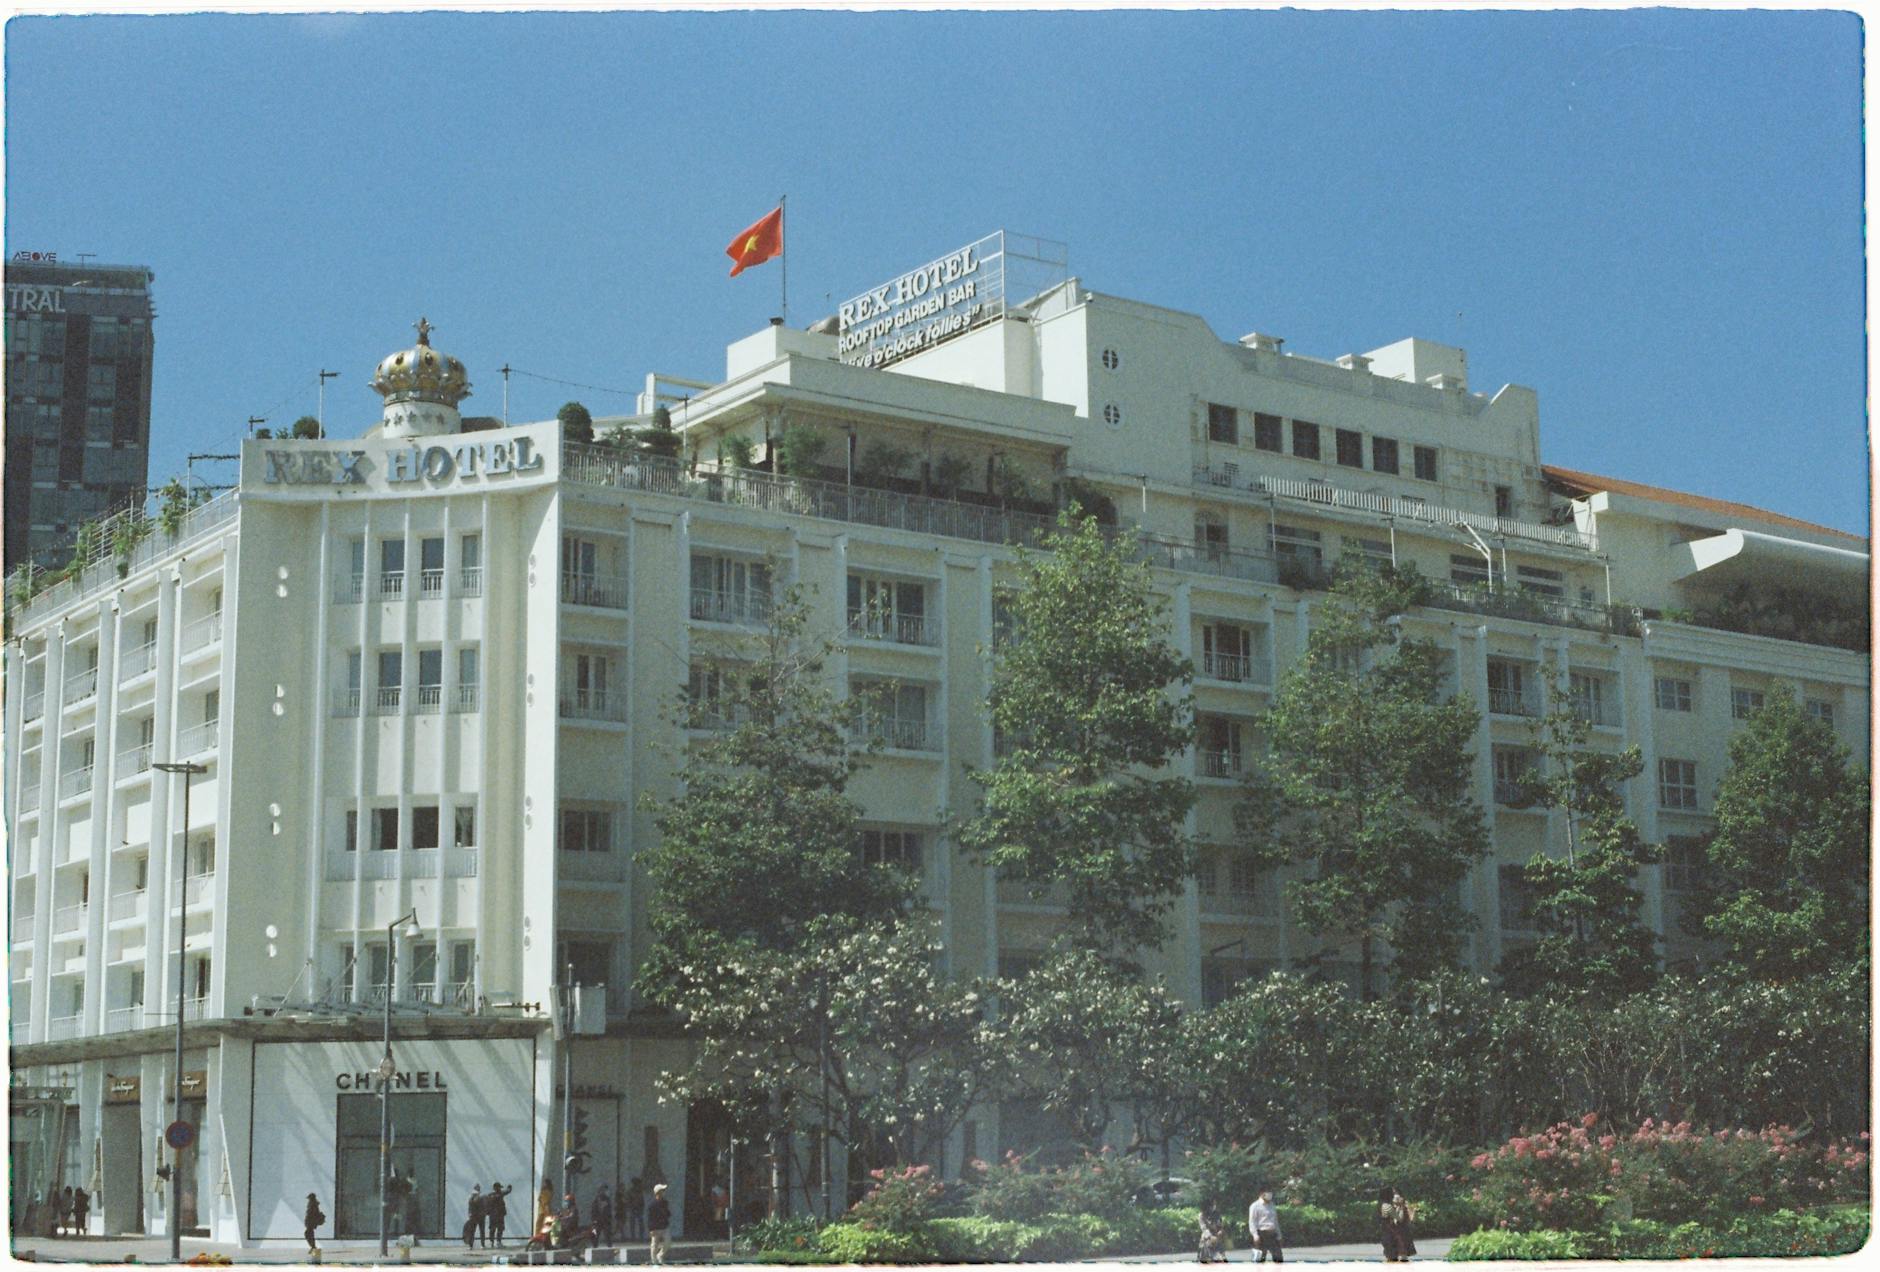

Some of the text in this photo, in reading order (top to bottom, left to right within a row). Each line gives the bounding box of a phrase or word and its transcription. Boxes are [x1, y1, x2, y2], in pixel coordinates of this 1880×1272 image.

[13, 252, 56, 262] ABOVE
[839, 248, 979, 331] REX HOTEL
[839, 281, 976, 354] ROOFTOP GARDEN BAR
[874, 329, 923, 363] o'clock
[264, 436, 544, 487] REX HOTEL
[336, 1071, 447, 1089] CHNEL
